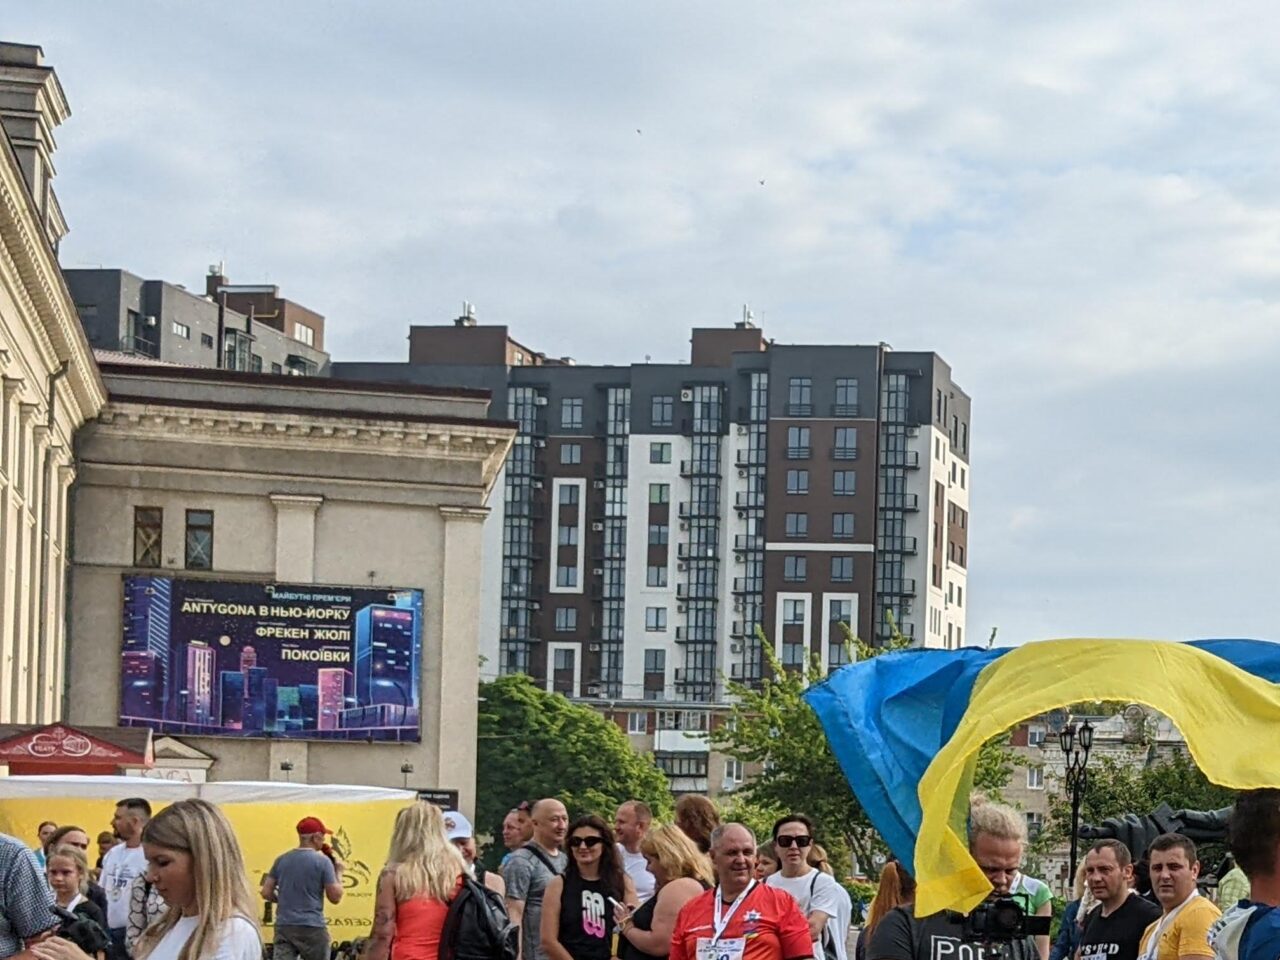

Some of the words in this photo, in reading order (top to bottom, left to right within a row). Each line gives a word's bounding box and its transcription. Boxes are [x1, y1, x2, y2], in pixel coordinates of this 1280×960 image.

[181, 602, 257, 616] ANTYGONA
[259, 606, 269, 616] В
[270, 606, 350, 620] НЬЮ-ЙОРКУ
[255, 627, 310, 639] ФРЕКЕН
[314, 630, 350, 640] ЖЮЛІ
[281, 648, 350, 662] ПОКОЇВКИ
